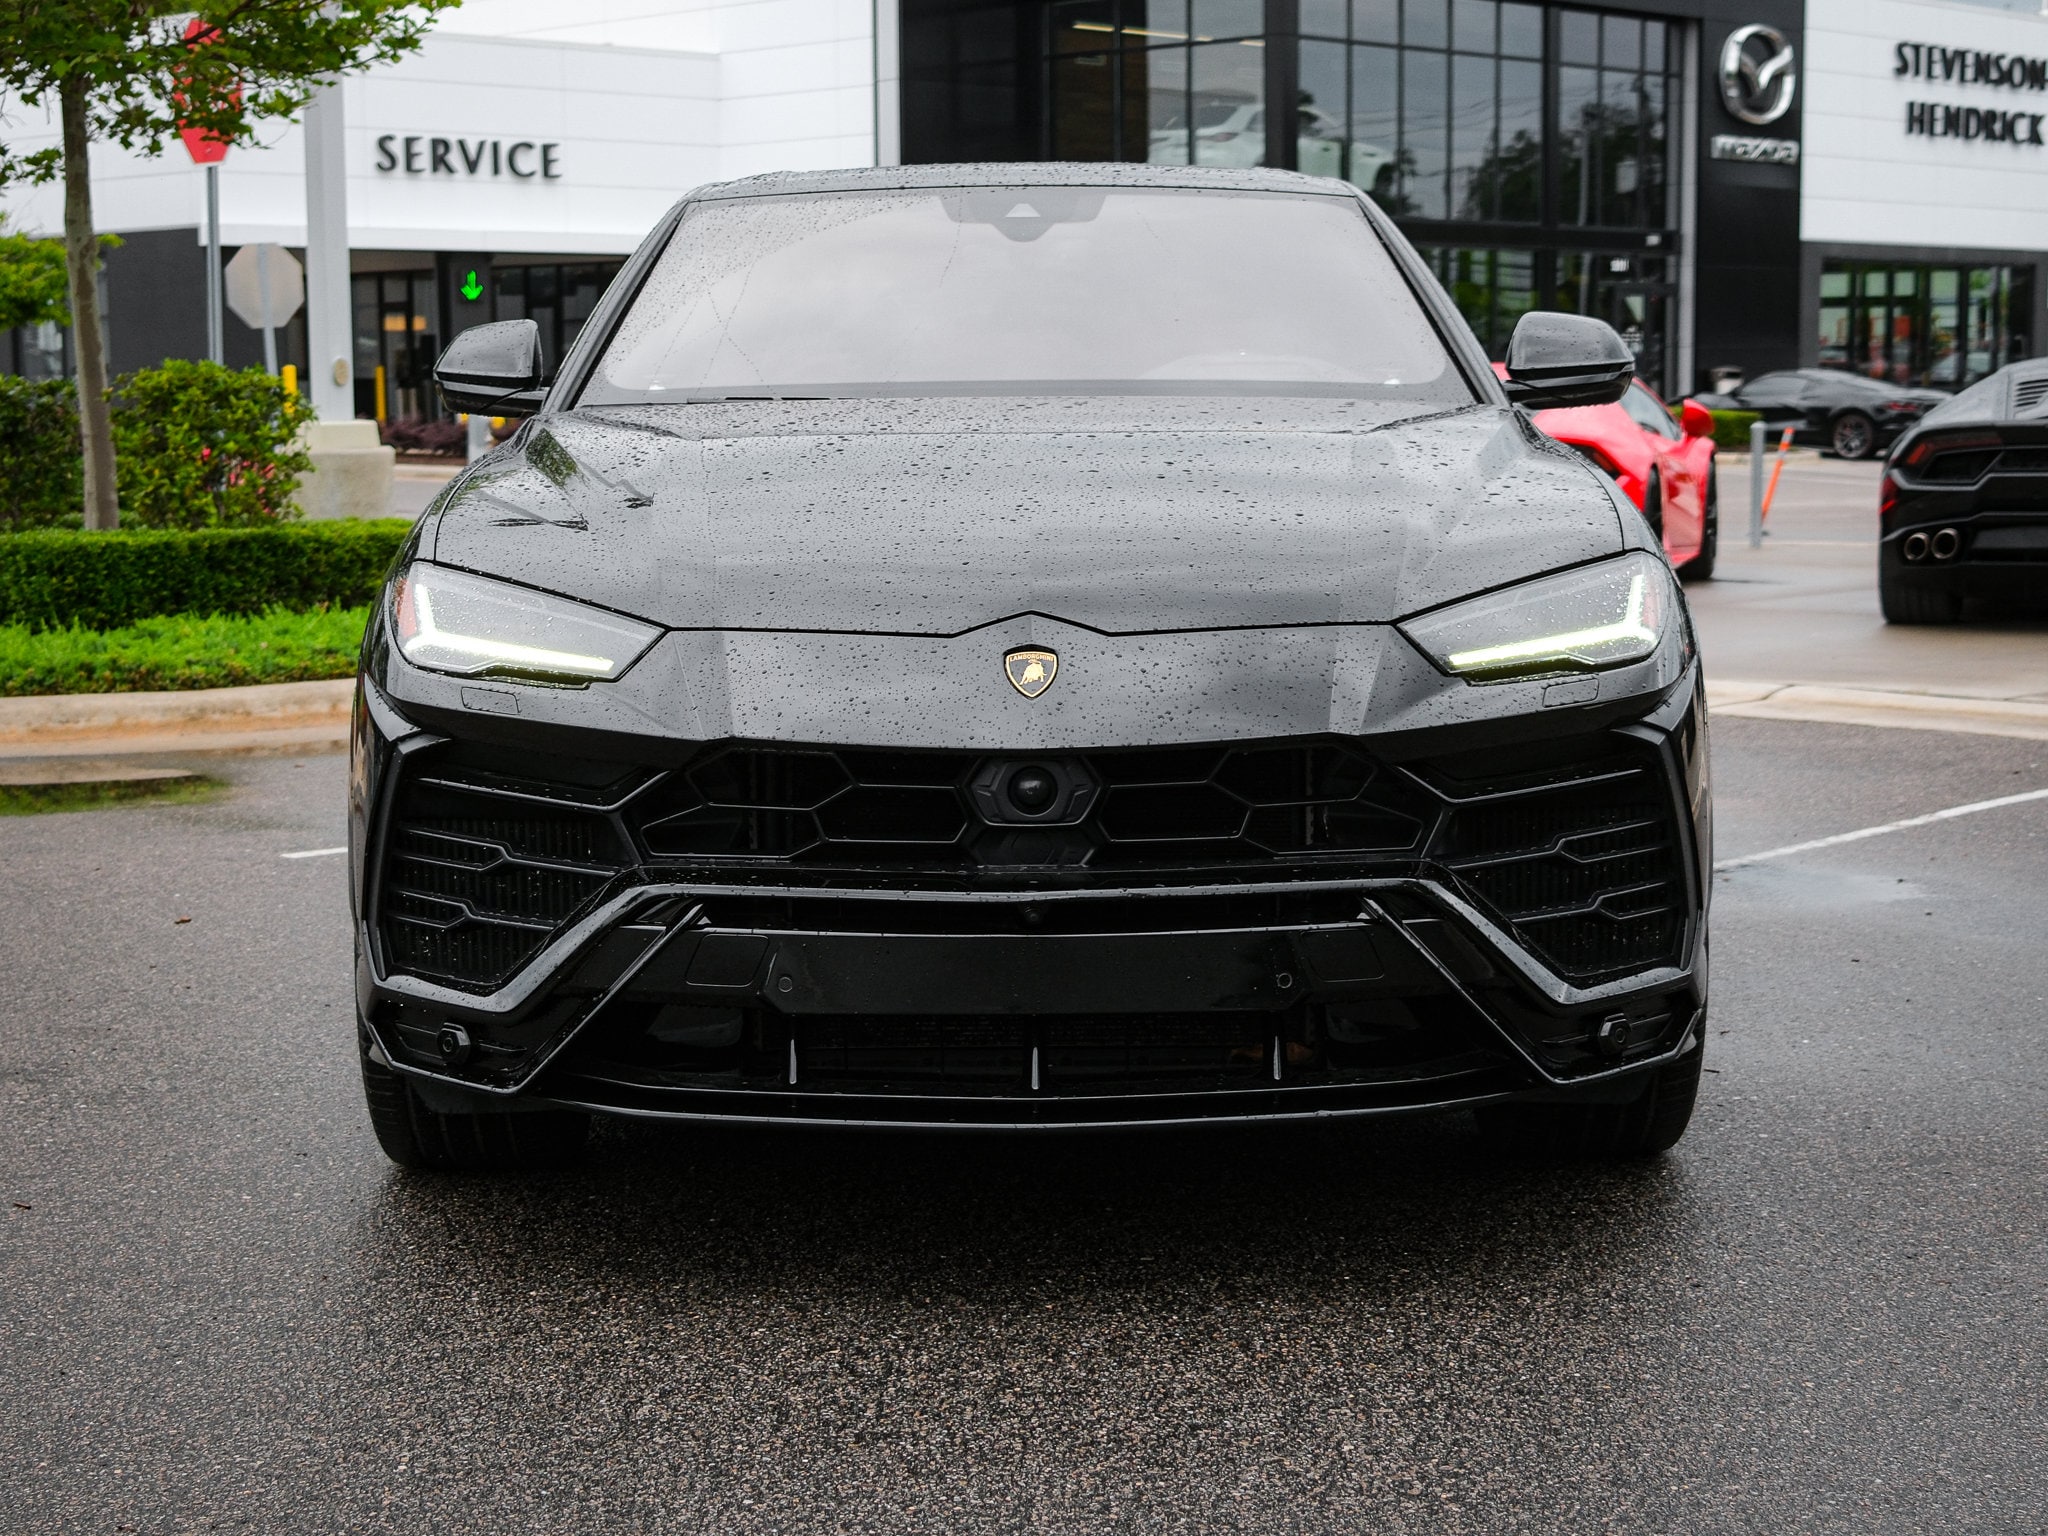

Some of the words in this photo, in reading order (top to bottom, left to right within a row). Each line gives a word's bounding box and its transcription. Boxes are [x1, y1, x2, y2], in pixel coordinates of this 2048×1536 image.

[1906, 101, 2045, 145] HENDRICK
[375, 134, 562, 179] SERVICE
[1009, 653, 1055, 662] LAMBORGHINI
